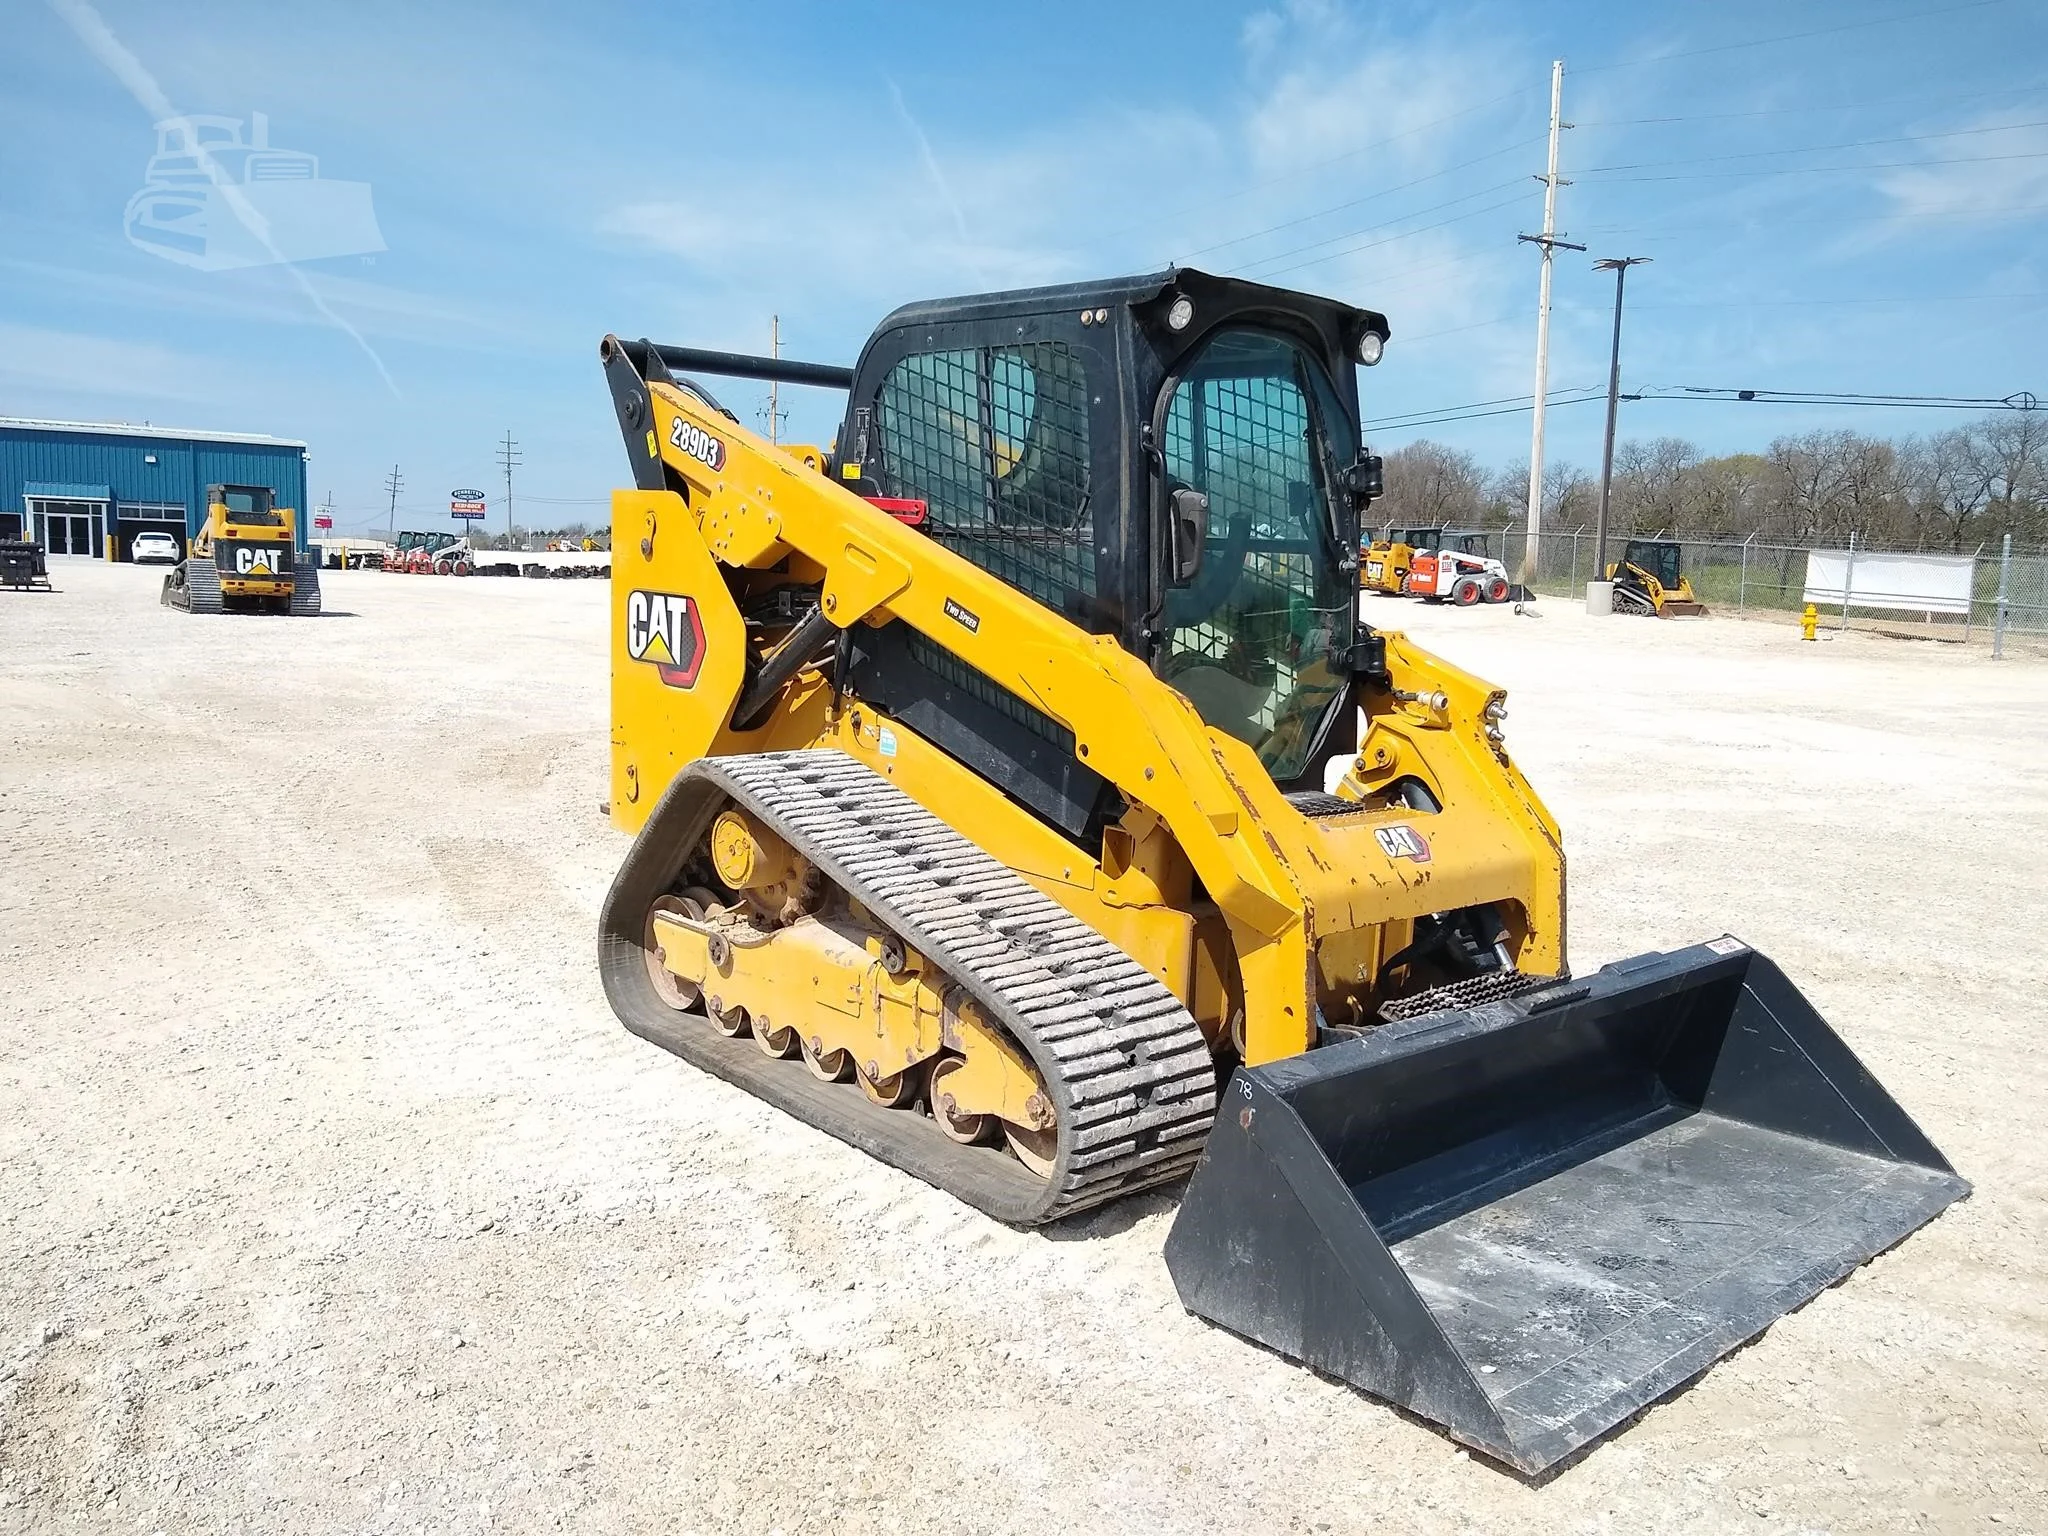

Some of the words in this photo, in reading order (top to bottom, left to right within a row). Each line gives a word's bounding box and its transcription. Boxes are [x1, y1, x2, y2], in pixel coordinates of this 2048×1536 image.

[671, 416, 719, 467] 289D3
[236, 548, 282, 575] CAT
[1367, 562, 1383, 579] CAT
[628, 590, 687, 666] CAT
[1374, 826, 1417, 858] CAT
[1235, 1078, 1253, 1100] 78
